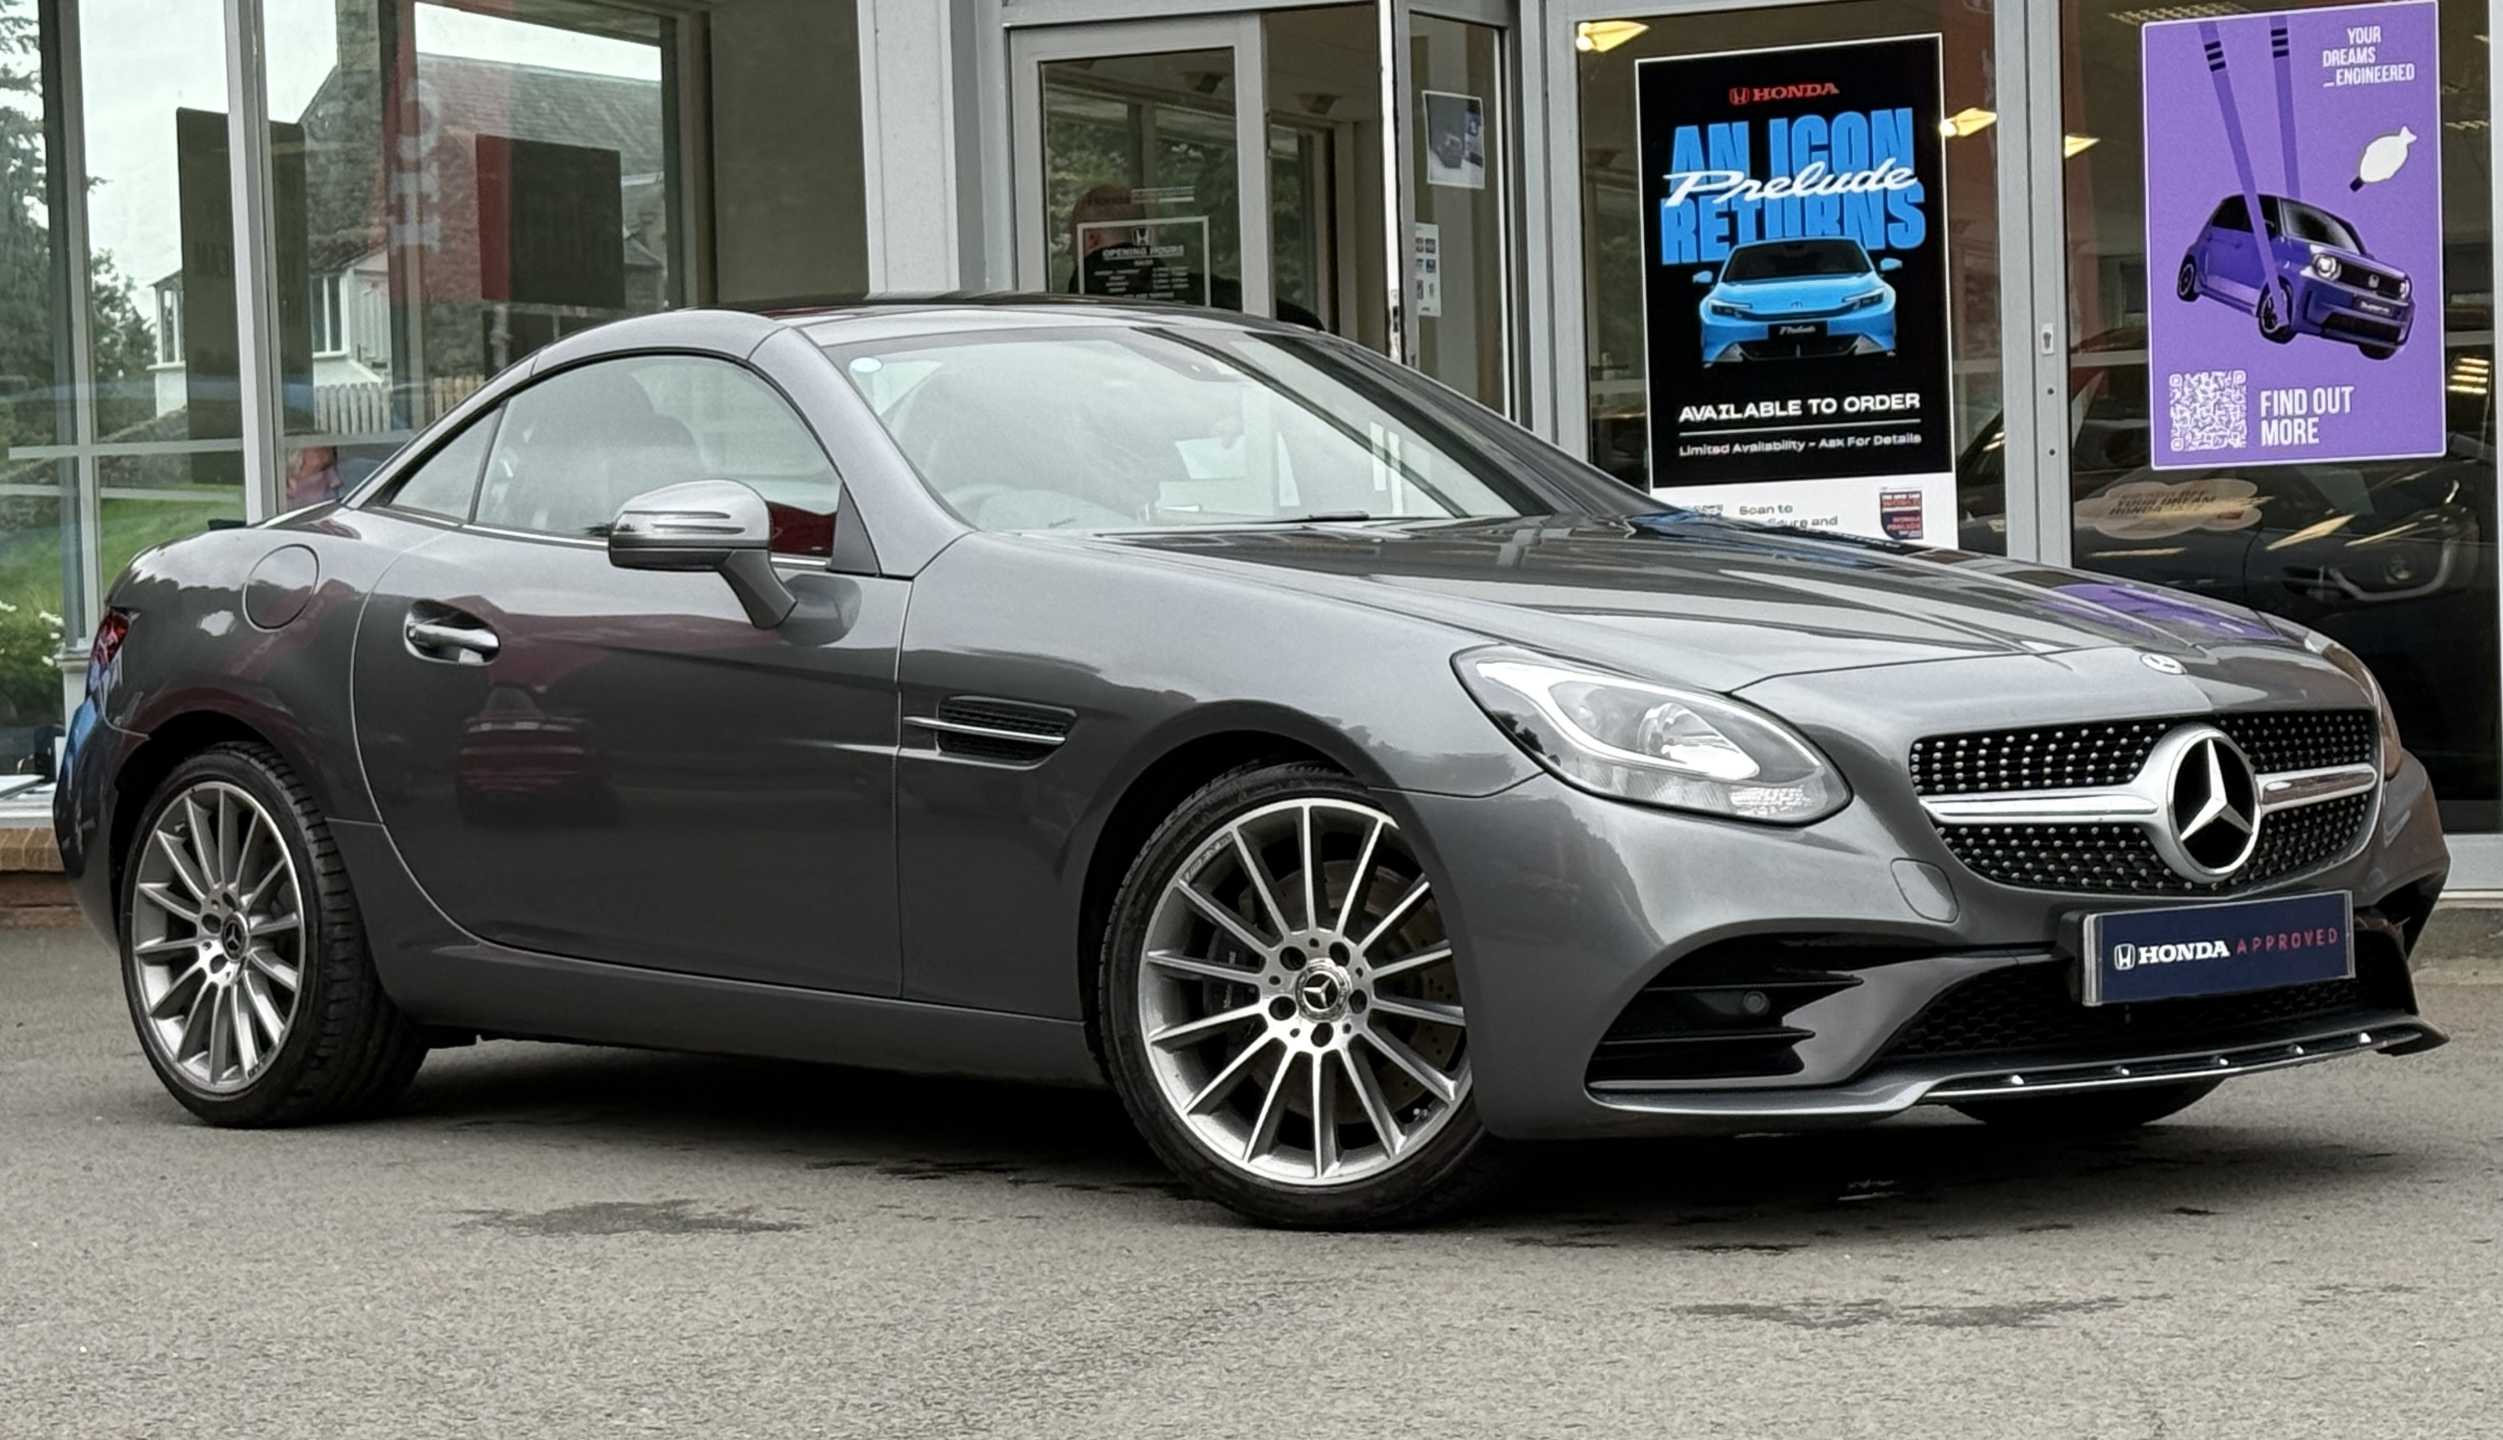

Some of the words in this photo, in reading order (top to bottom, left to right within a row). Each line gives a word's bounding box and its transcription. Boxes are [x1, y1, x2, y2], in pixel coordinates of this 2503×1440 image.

[2346, 25, 2382, 45] YOUR
[2322, 46, 2376, 67] DREAMS
[1752, 82, 1840, 102] HONDA
[1670, 120, 1750, 192] AN
[1769, 107, 1914, 178] ICON
[1663, 158, 1918, 208] Prelude
[1660, 182, 1926, 266] RETURNS
[1678, 400, 1803, 423] AVAILABLE
[1808, 397, 1837, 415] TO
[1844, 392, 1921, 413] ORDER
[2260, 389, 2307, 416] FIND
[2312, 386, 2354, 414] OUT
[1679, 443, 1730, 457] Limited
[1733, 438, 1806, 454] Availability
[1818, 437, 1845, 450] Ask
[1847, 435, 1871, 448] For
[1874, 432, 1922, 446] Details
[2260, 417, 2319, 446] MORE
[1739, 505, 1775, 515] Scan
[1777, 504, 1794, 514] to
[1811, 516, 1838, 526] and
[2138, 940, 2231, 965] HONDA
[2235, 927, 2340, 955] APPROVED
